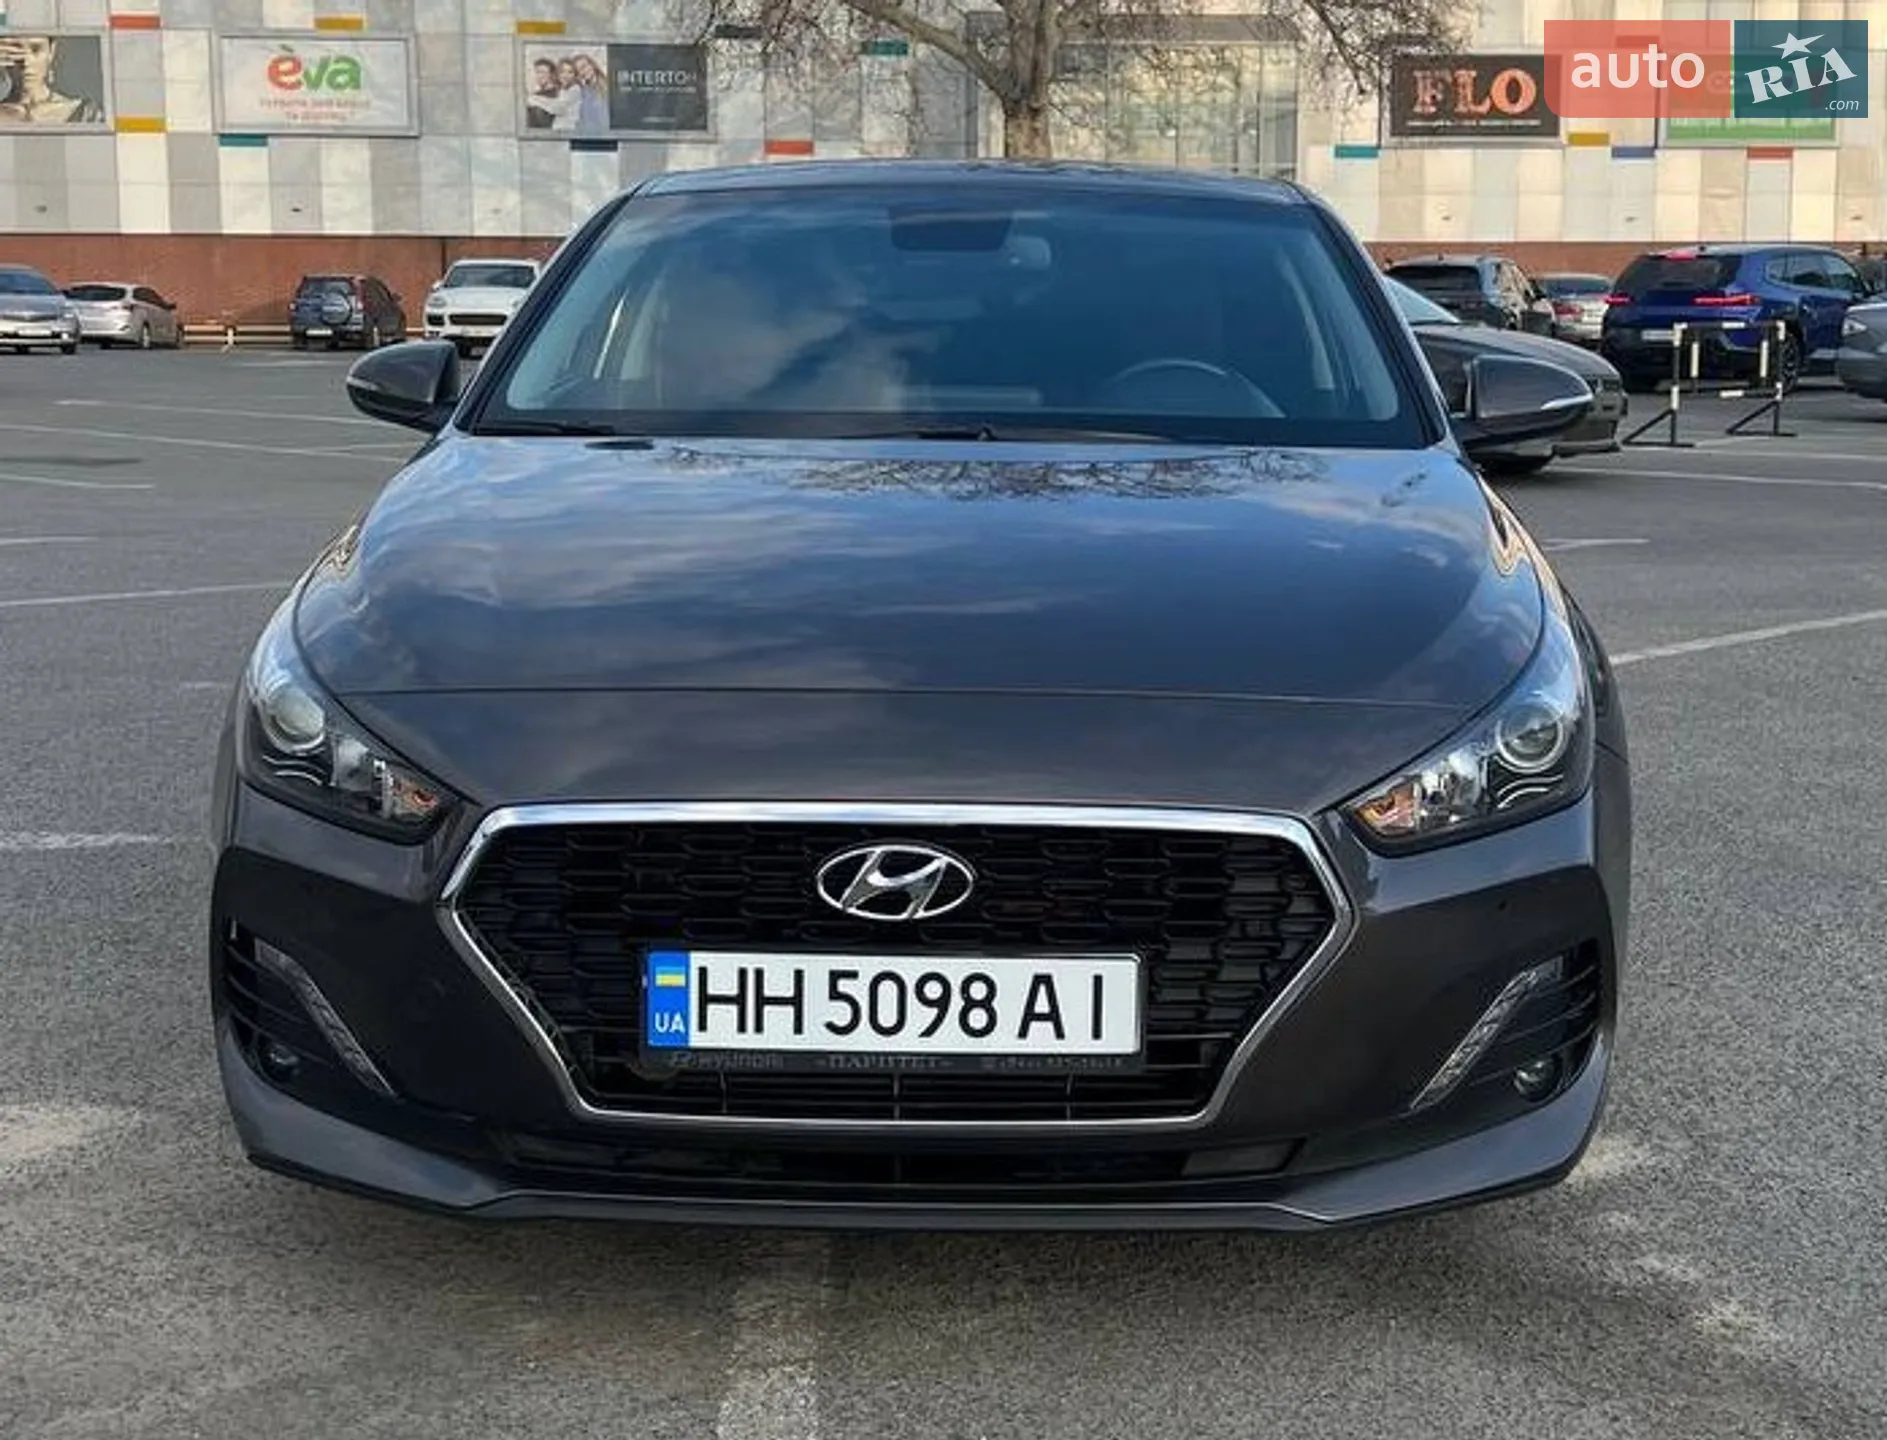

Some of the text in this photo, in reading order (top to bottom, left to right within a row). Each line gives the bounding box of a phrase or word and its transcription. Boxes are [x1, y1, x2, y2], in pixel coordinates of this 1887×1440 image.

[1412, 68, 1537, 114] FLO
[655, 1012, 685, 1033] UA
[698, 966, 804, 1035] HH
[824, 970, 998, 1039] 5098
